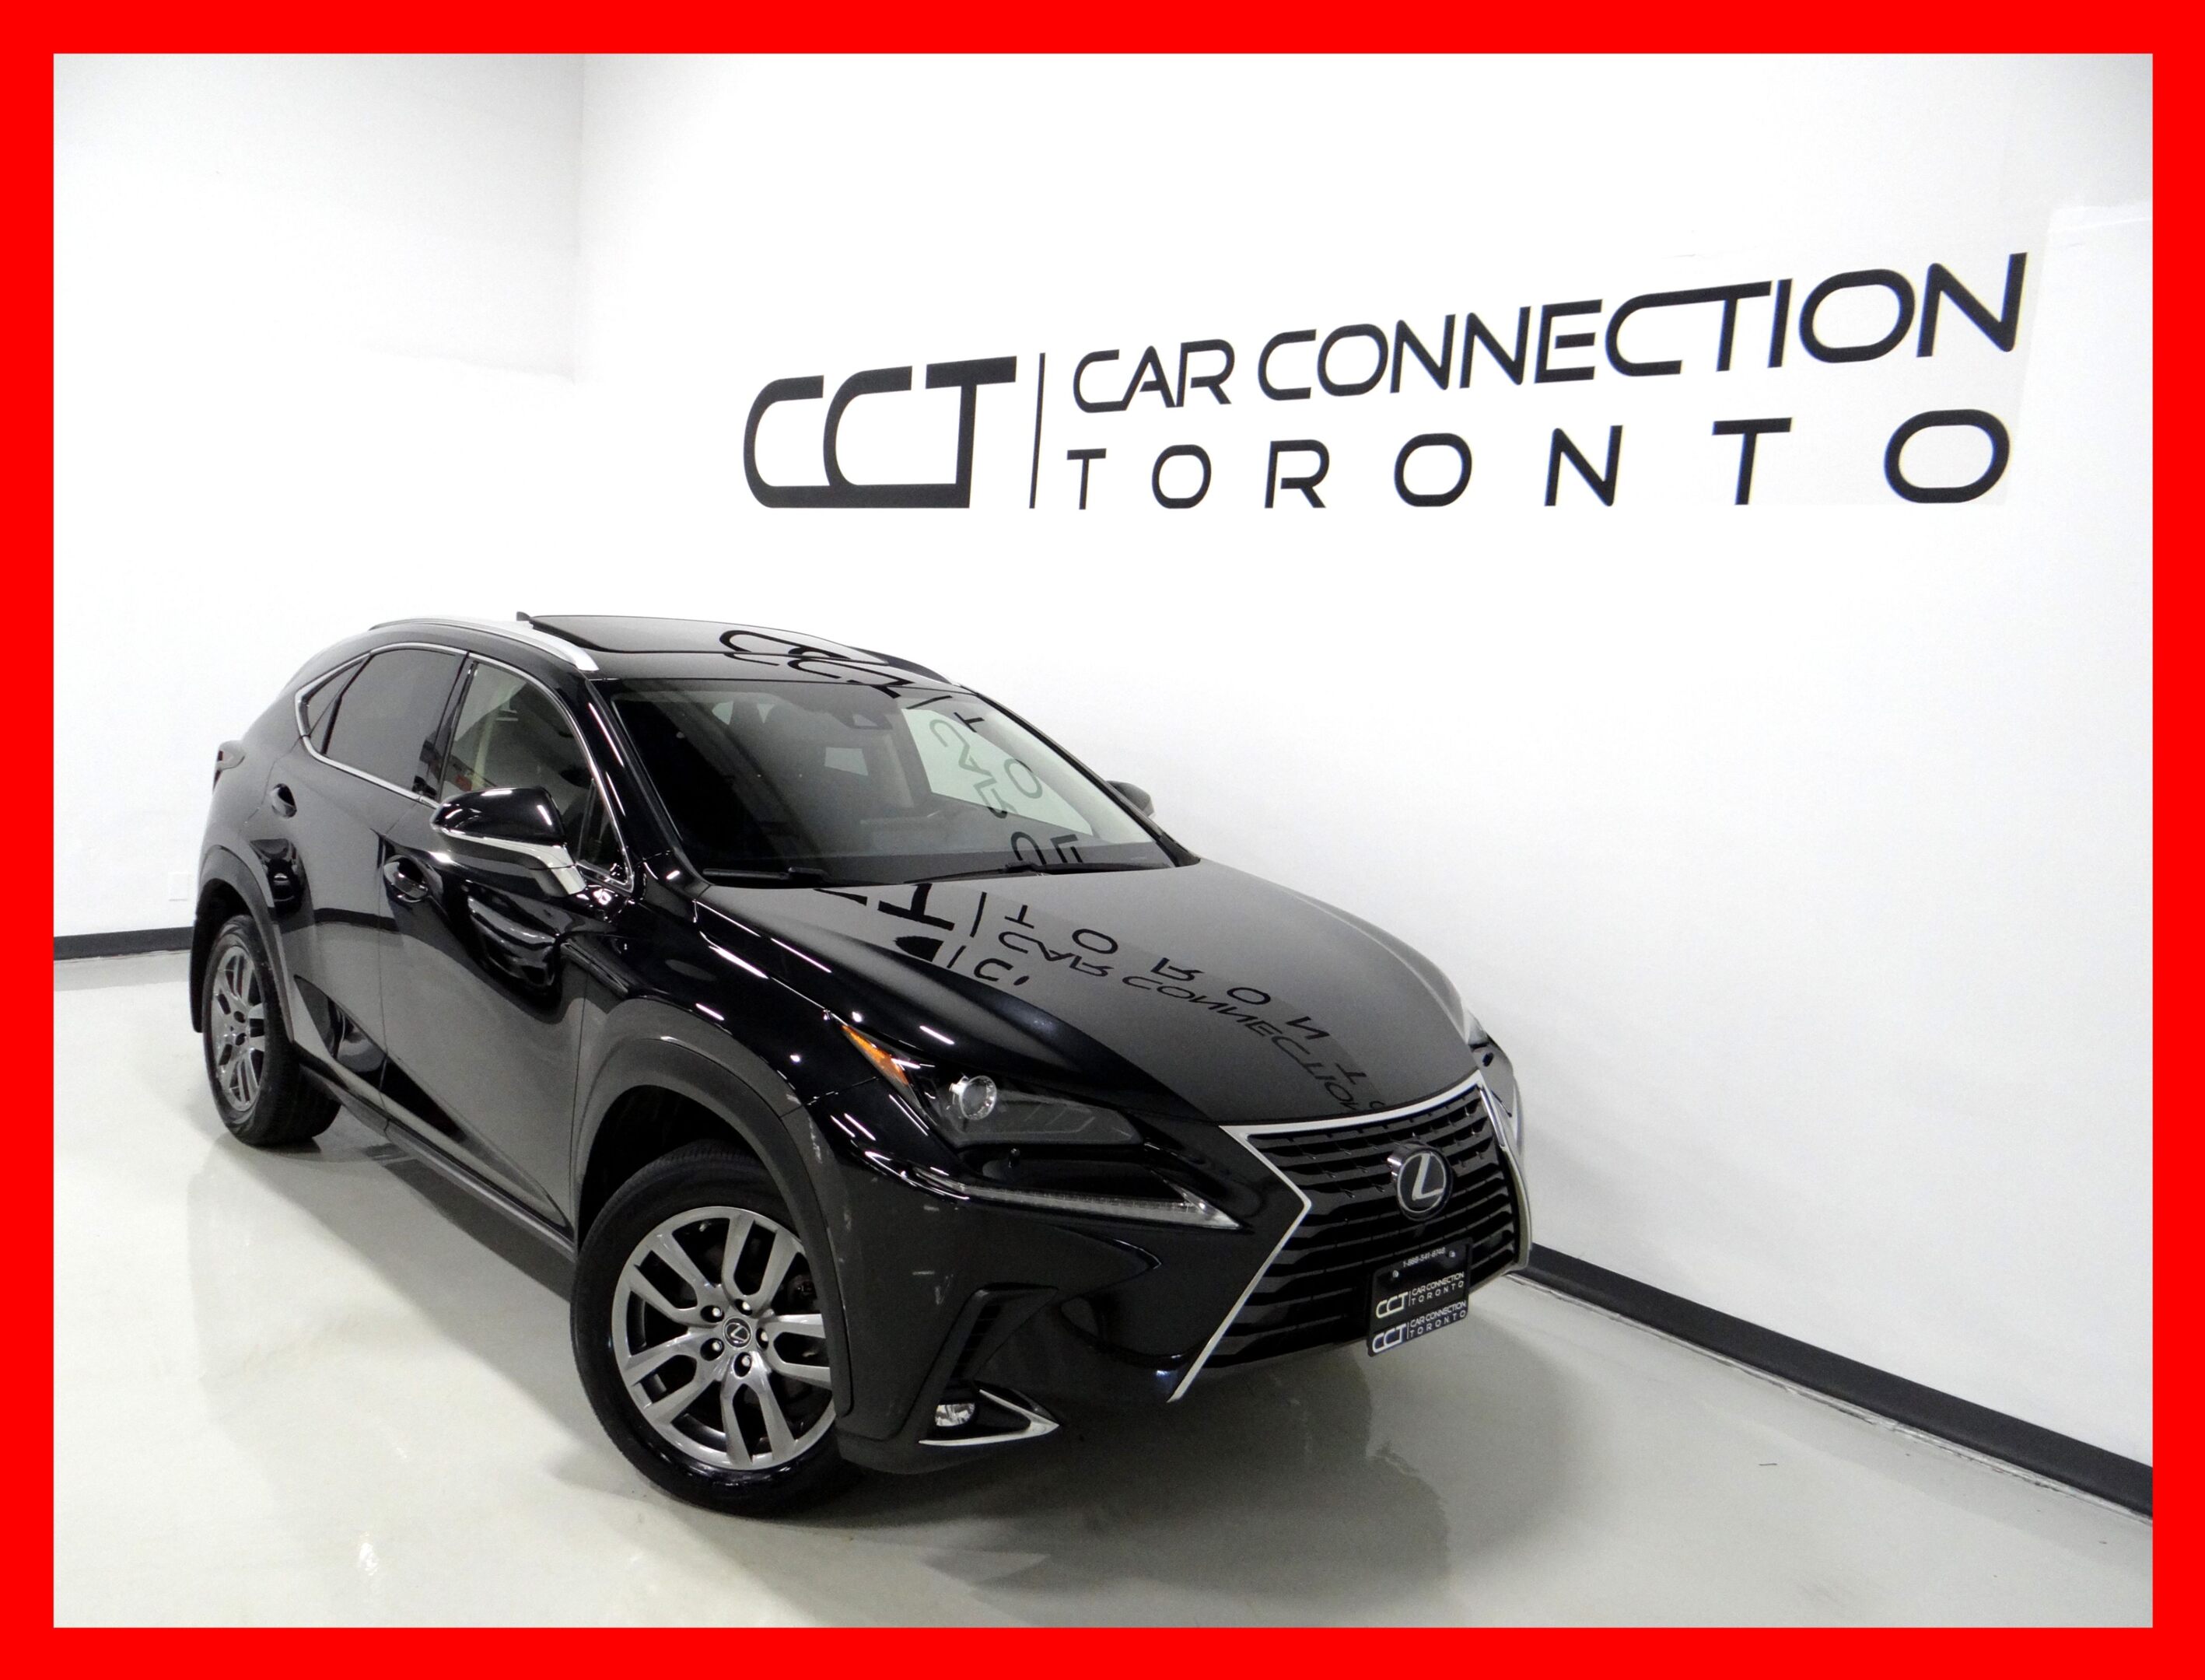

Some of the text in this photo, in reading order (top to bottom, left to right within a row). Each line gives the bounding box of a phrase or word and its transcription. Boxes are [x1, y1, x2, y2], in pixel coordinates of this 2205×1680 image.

[1073, 253, 2027, 413] CAR CONNECTION
[744, 356, 1017, 509] CCT
[1067, 409, 2010, 509] TORONTO
[1411, 1280, 1465, 1305] TORONTO
[1412, 1271, 1465, 1297] CAR CONNECTION
[1376, 1291, 1409, 1318] CCT
[1410, 1300, 1467, 1328] CAR CONNECTION
[1372, 1323, 1407, 1353] CCT
[1409, 1310, 1467, 1339] TORONTO
